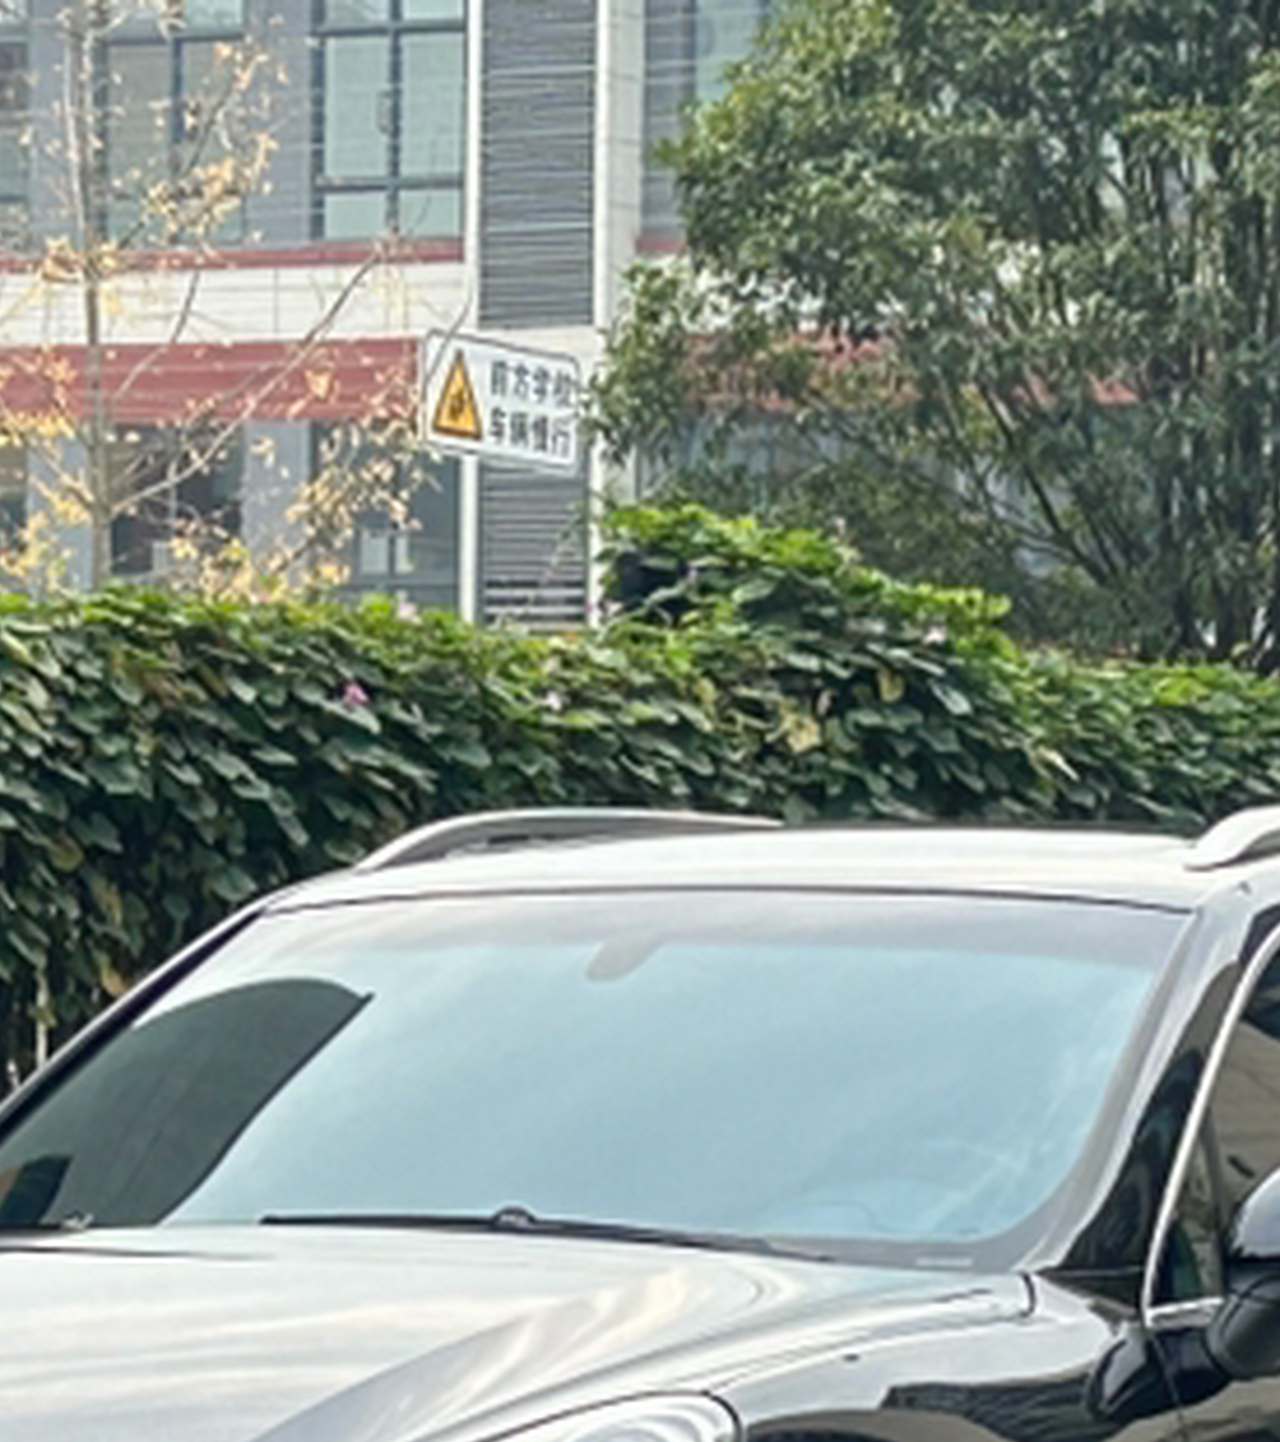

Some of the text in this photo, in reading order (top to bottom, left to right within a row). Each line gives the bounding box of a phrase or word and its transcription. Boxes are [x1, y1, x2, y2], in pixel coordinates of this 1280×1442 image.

[490, 360, 575, 408] 前方学校
[489, 405, 571, 458] 车辆慢行
